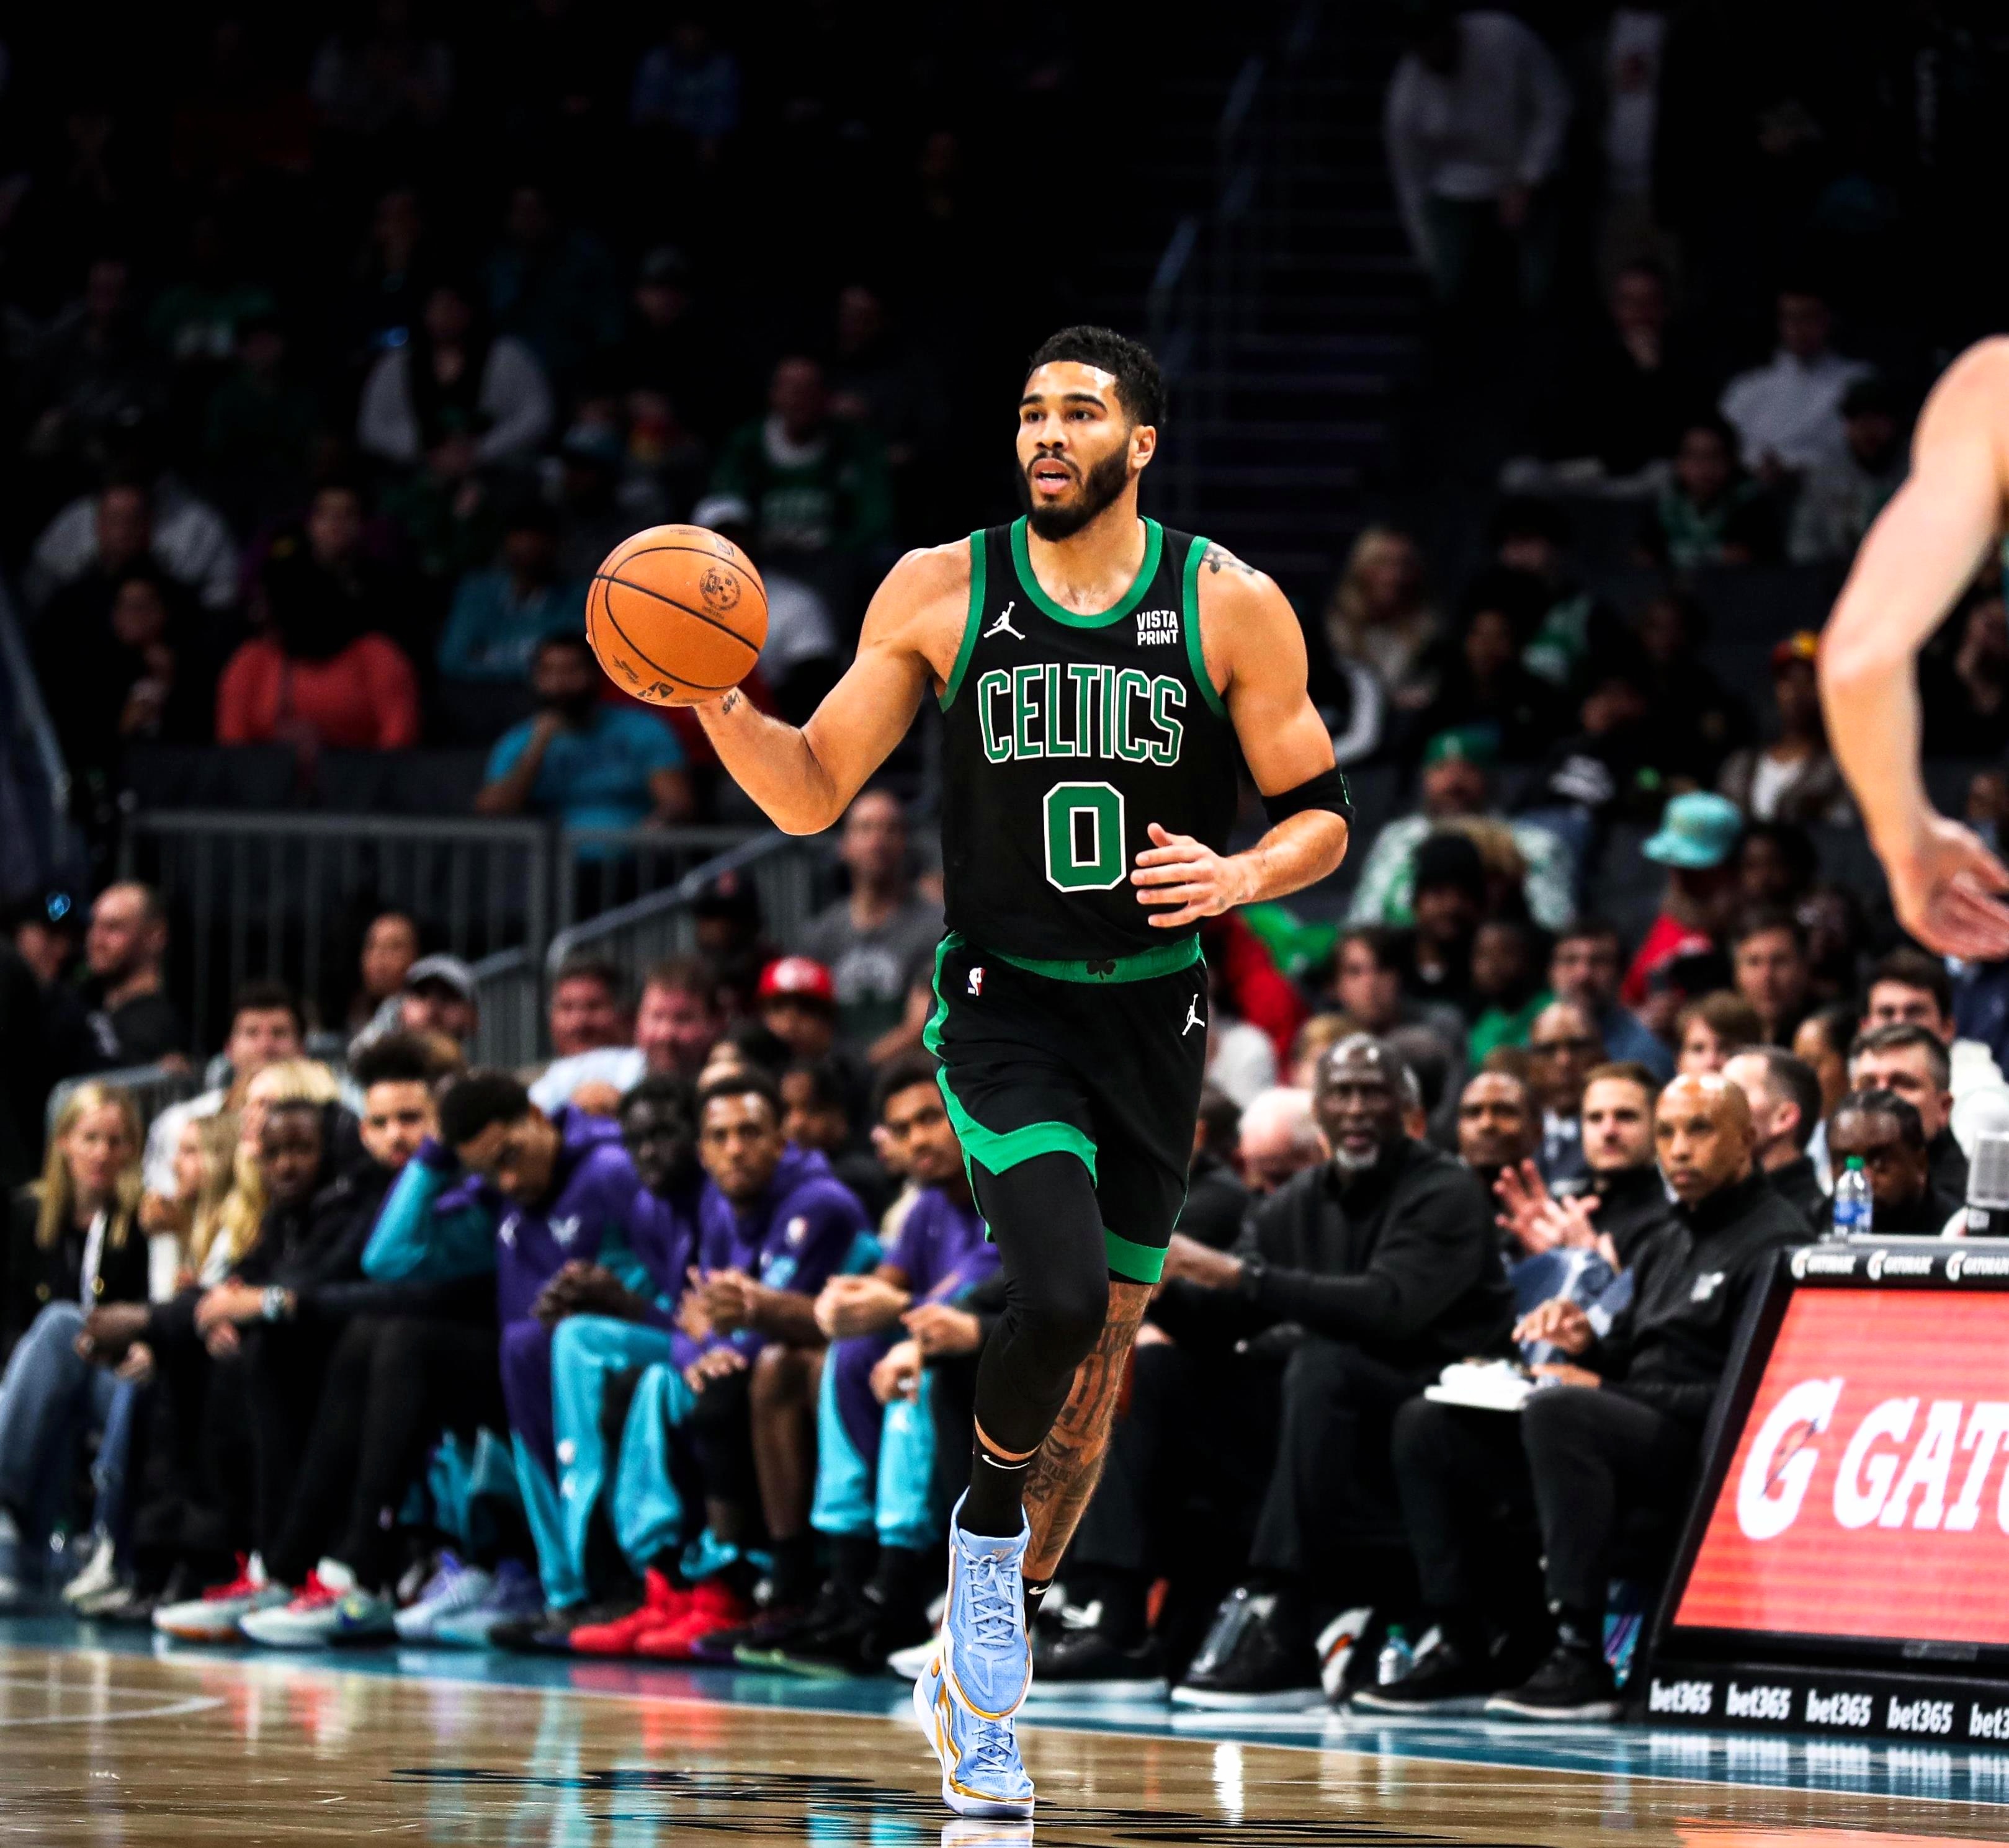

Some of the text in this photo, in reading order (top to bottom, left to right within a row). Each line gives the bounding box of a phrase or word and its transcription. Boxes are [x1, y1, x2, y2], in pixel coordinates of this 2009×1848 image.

[1136, 610, 1178, 631] VISTA
[1137, 629, 1178, 646] PRINT
[977, 663, 1186, 767] CELTICS
[1043, 781, 1127, 893] 0
[1736, 1376, 2009, 1542] G GAT
[1649, 1679, 1713, 1714] bet365
[1725, 1682, 1792, 1720] bet365
[1805, 1689, 1873, 1727] bet365
[1887, 1695, 1954, 1734] bet365
